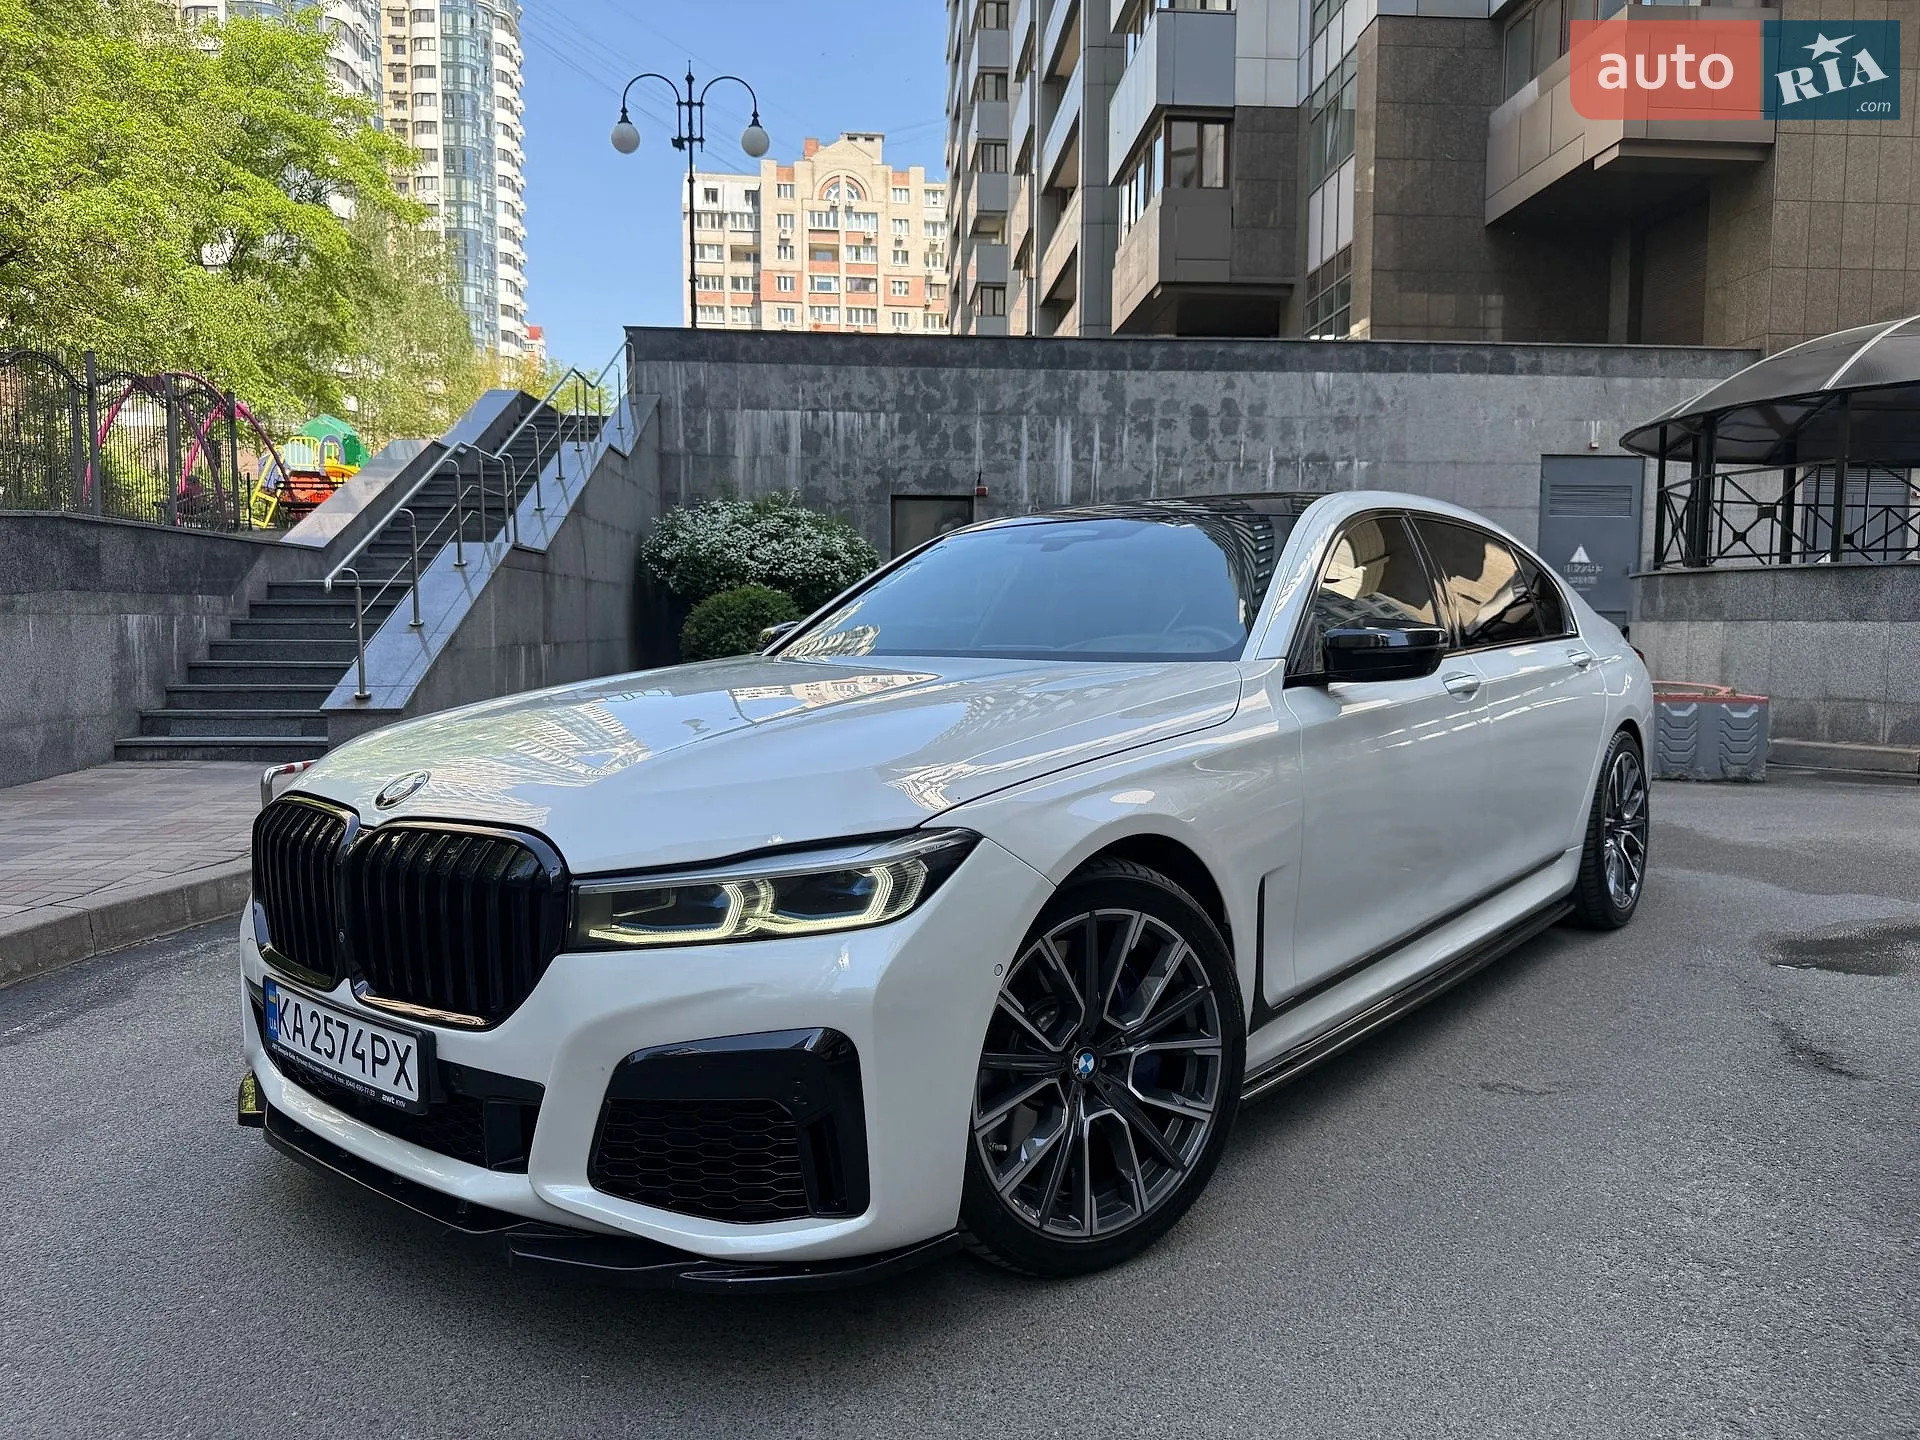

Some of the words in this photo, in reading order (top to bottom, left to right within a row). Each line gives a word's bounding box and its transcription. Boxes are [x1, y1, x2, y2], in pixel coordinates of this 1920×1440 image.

[269, 1017, 277, 1032] UA
[277, 993, 306, 1048] KA
[310, 1010, 366, 1074] 2574
[370, 1032, 414, 1092] PX
[381, 1093, 395, 1105] awt
